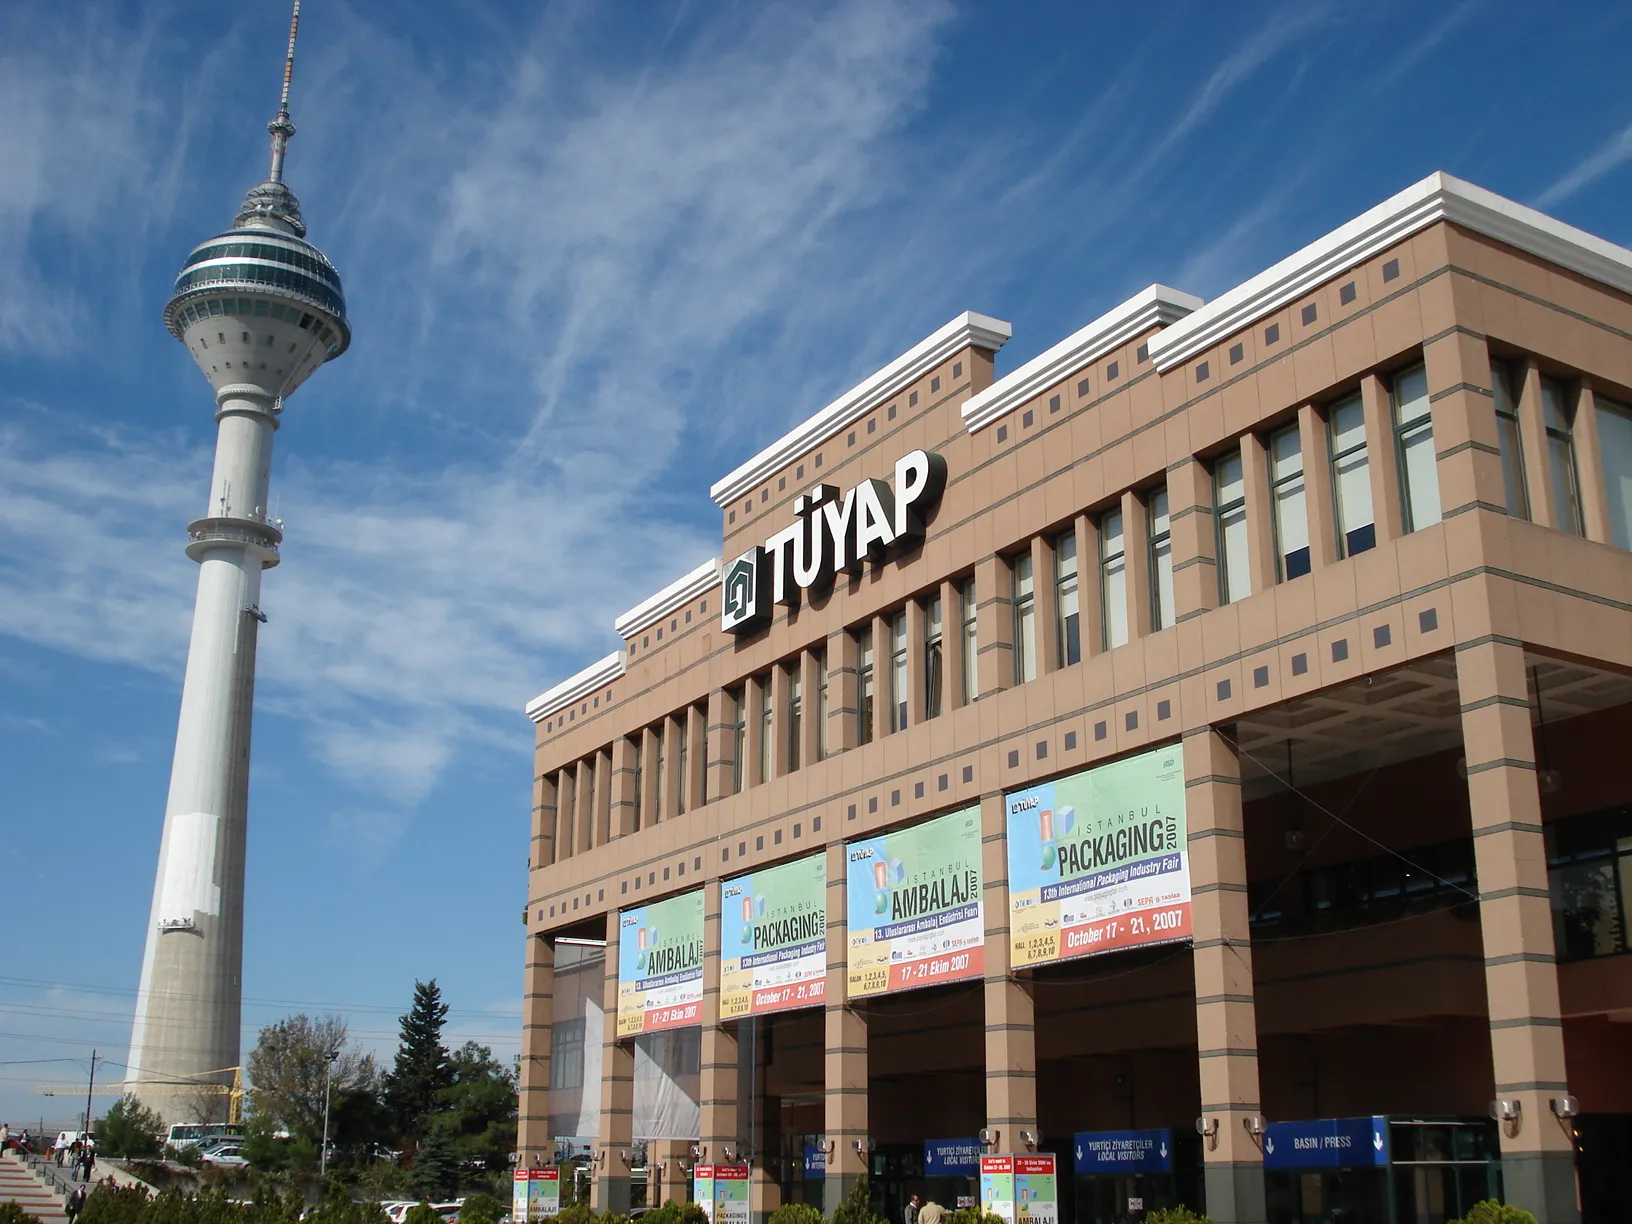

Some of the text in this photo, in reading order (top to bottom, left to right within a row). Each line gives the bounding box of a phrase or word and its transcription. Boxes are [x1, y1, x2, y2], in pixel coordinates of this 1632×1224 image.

[764, 449, 932, 605] TÜYAP
[1058, 819, 1164, 876] PACKAGING
[1166, 816, 1177, 850] 2007
[970, 869, 978, 899] 2007
[1043, 857, 1180, 900] 13th International Packaging Industry Fair
[892, 870, 969, 921] AMBALAJ
[754, 911, 819, 950] PACKAGING
[874, 930, 884, 940] 13.
[917, 916, 938, 931] Ambalaj
[939, 910, 964, 926] Endüstrisi
[1067, 926, 1104, 949] October
[1105, 922, 1117, 939] 17
[1130, 916, 1150, 935] 21,
[1152, 909, 1183, 931] 2007
[648, 940, 699, 976] AMBALAJ
[778, 948, 801, 960] Packaging
[901, 967, 911, 980] 17
[918, 964, 928, 978] 21
[930, 961, 949, 976] Ekim
[951, 954, 970, 972] 2007
[756, 990, 781, 1006] October
[781, 988, 790, 1002] 17
[797, 985, 808, 1000] 21,
[809, 982, 825, 998] 2007
[652, 1012, 660, 1024] 17
[662, 1010, 670, 1023] 21
[670, 1009, 684, 1021] Ekim
[1088, 1138, 1153, 1152] YURTİÇİ ZİYARETÇİLER
[1097, 1150, 1145, 1161] LOCAL VISITORS
[1294, 1137, 1318, 1149] BASIN
[1325, 1136, 1351, 1148] PRESS
[943, 1155, 959, 1165] LOCAL
